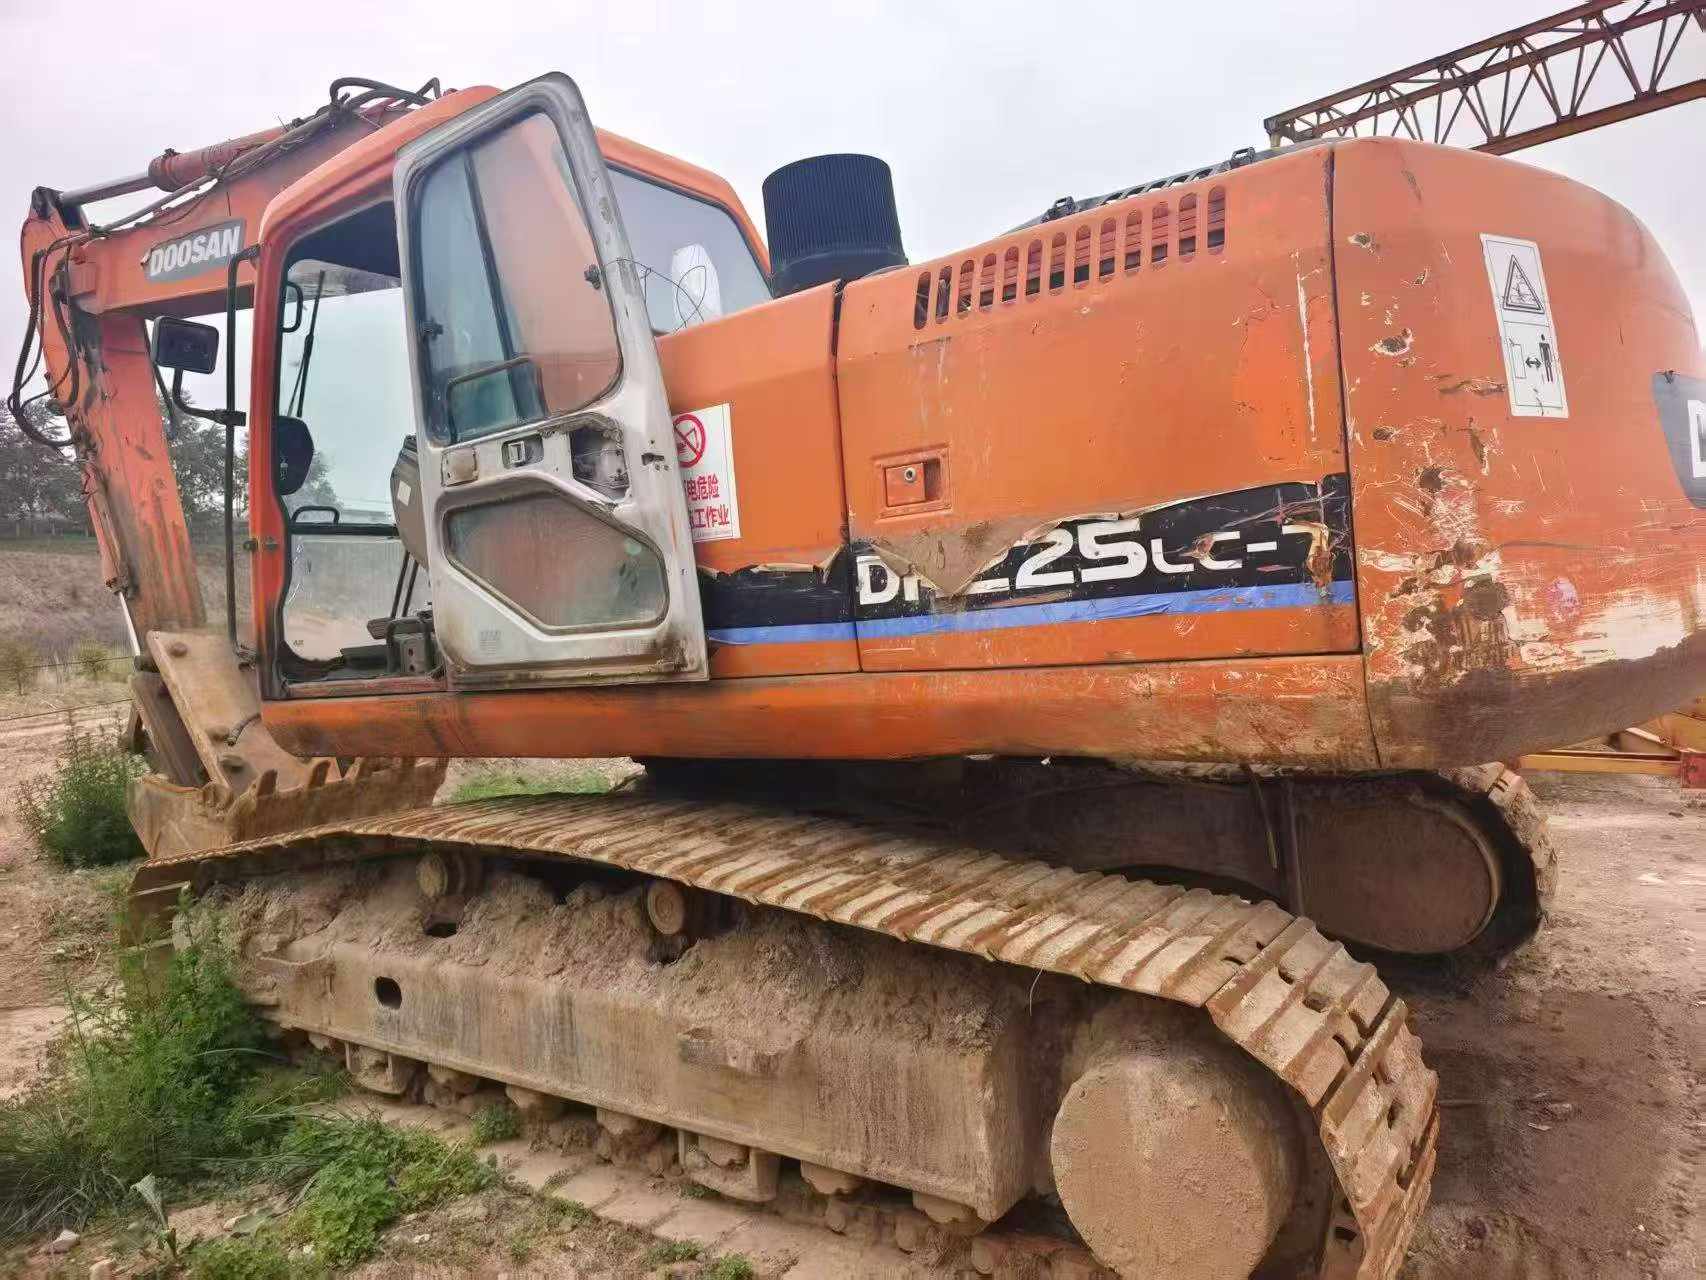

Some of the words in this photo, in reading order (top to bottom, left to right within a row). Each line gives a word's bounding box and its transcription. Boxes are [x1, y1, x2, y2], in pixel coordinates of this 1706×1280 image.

[150, 225, 240, 277] DOOSAN
[684, 473, 720, 501] 电危险
[689, 503, 730, 529] 工作业
